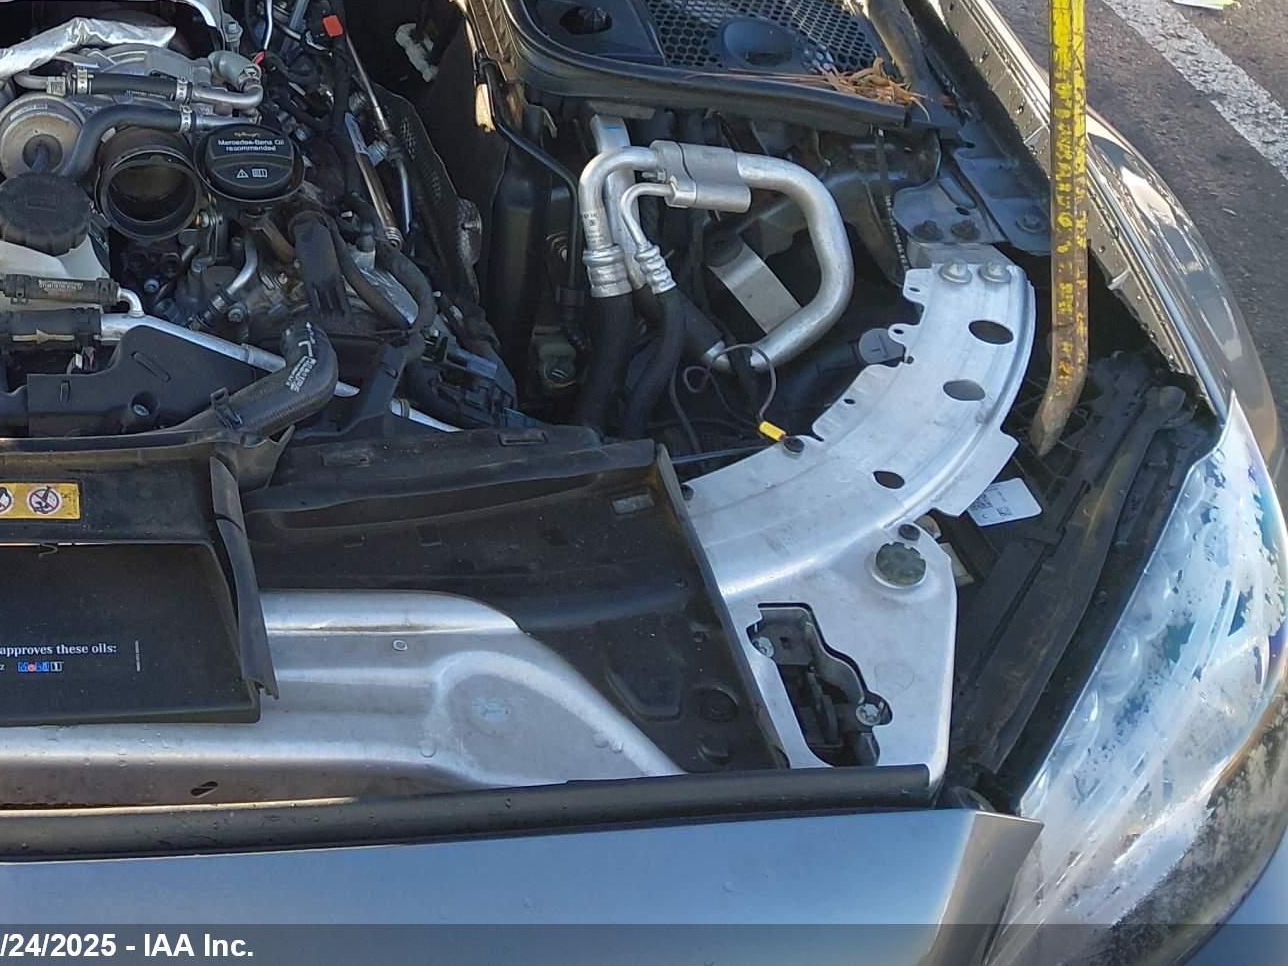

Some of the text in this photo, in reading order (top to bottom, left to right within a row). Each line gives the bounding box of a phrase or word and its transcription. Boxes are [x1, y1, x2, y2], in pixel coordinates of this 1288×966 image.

[0, 644, 53, 658] approves
[56, 644, 89, 654] these
[91, 643, 117, 654] oils:
